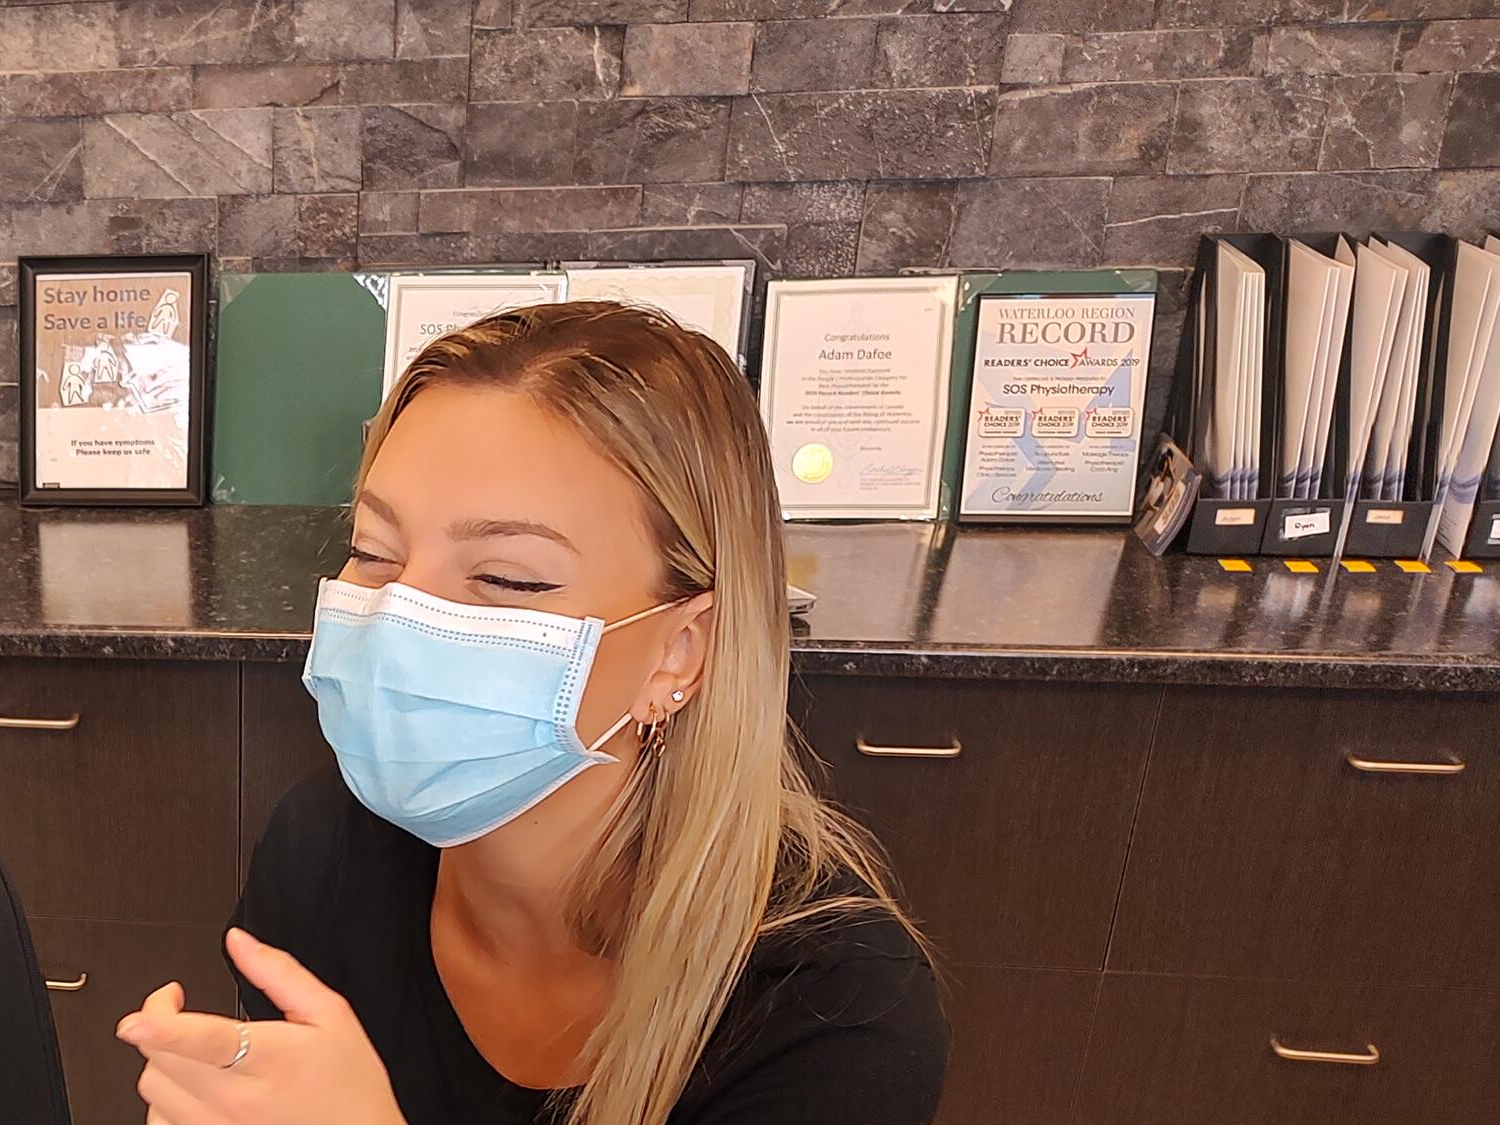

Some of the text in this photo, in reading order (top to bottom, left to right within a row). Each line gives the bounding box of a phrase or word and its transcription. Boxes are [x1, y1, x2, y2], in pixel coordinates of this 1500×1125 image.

[43, 285, 151, 306] Stay home
[999, 307, 1136, 319] WATERLOO REGION
[44, 311, 146, 330] Save a life
[420, 324, 443, 335] SOS
[996, 322, 1135, 344] RECORD
[824, 333, 890, 343] Congratulations
[818, 348, 892, 360] Adam Dafoe
[984, 358, 1140, 367] READERS' CHOICE AWARDS 2019
[1003, 383, 1115, 397] SOS Physiotherapy
[992, 486, 1103, 504] Congratulations
[1294, 522, 1315, 531] Ryan
